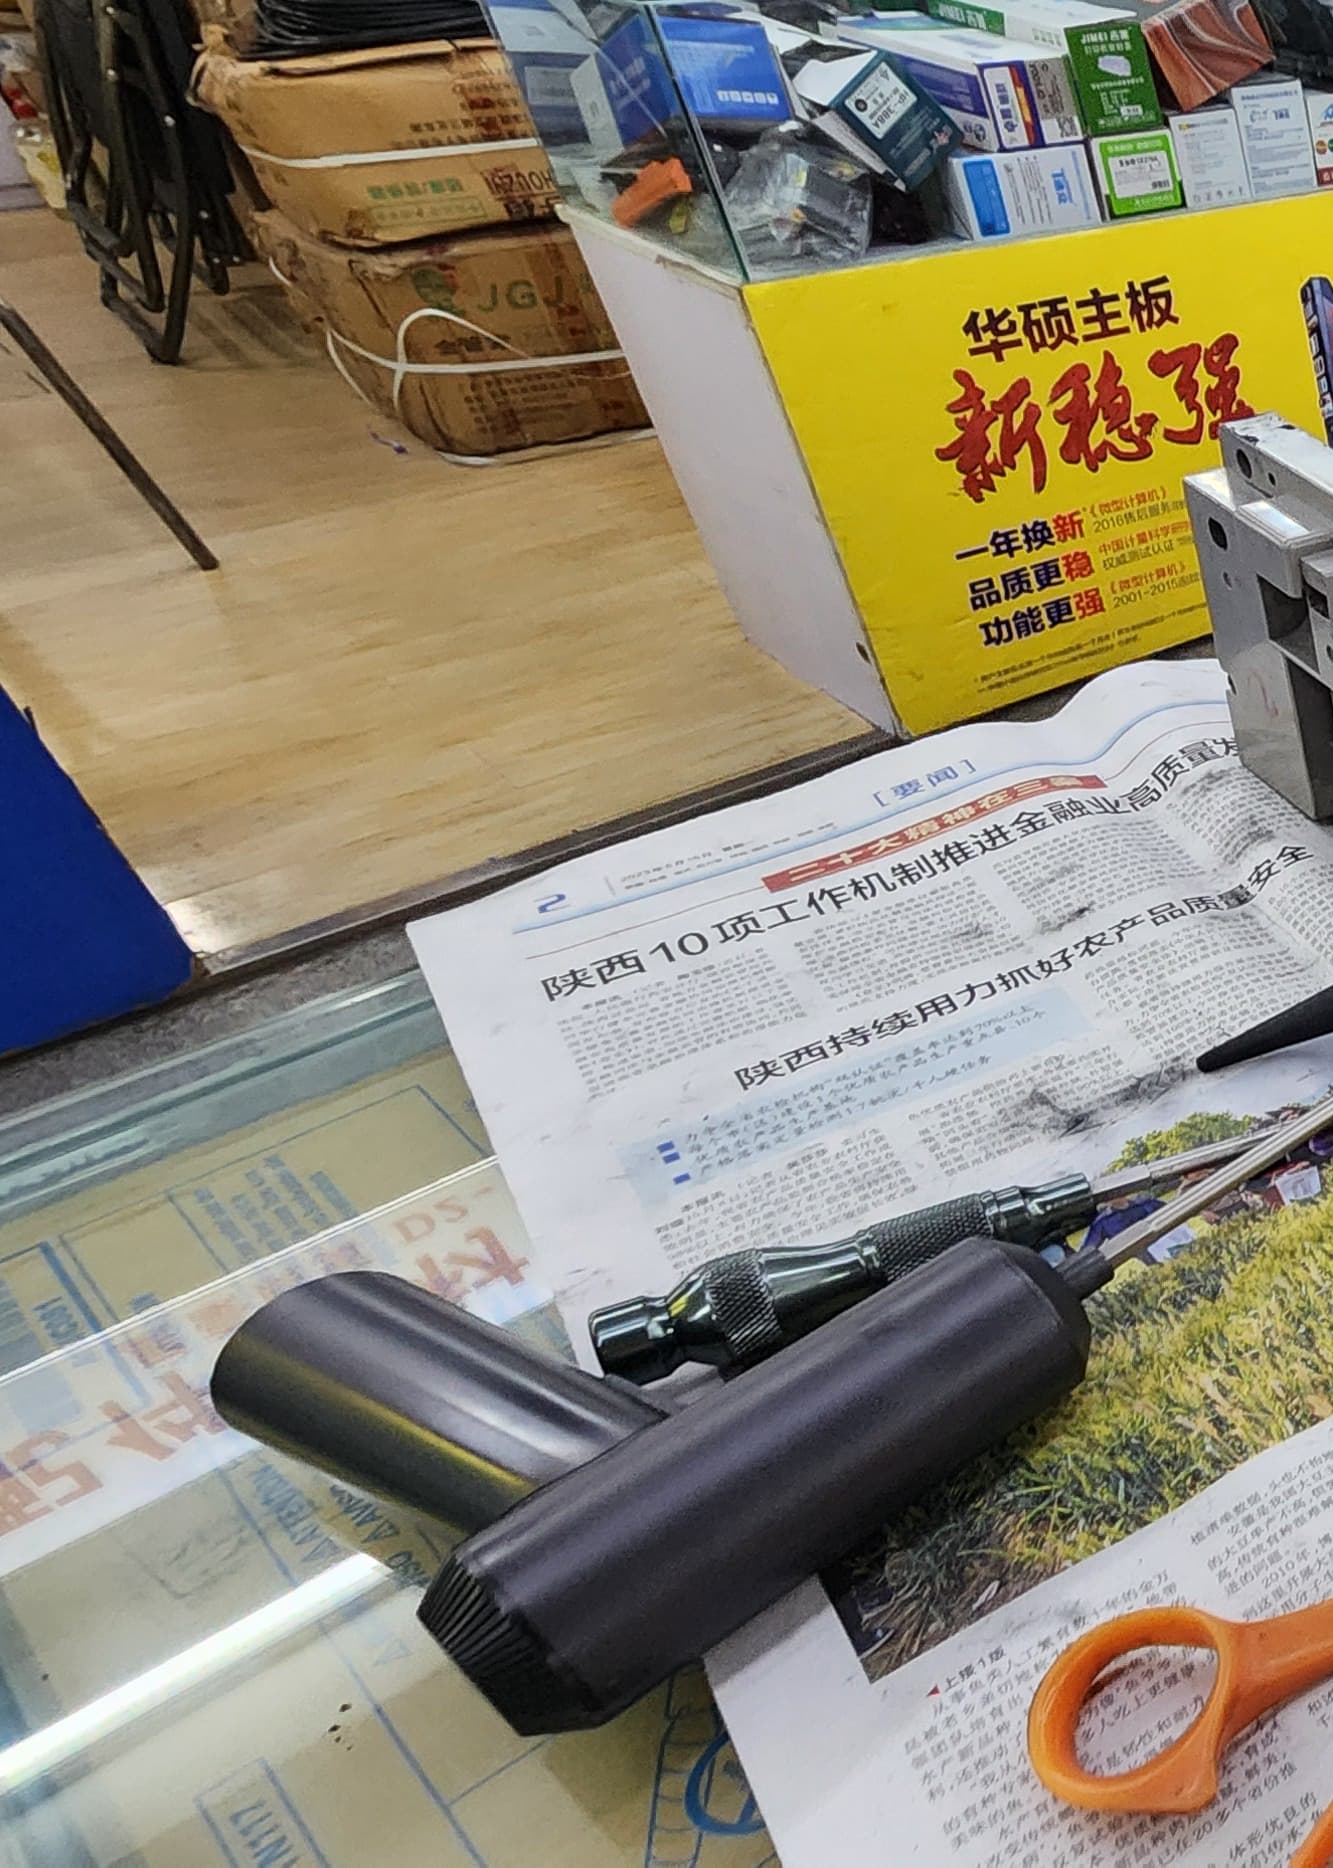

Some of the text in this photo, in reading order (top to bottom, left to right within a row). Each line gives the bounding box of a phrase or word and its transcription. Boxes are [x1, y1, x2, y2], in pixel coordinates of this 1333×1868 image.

[961, 275, 1180, 363] 华硕主板
[935, 333, 1258, 502] 新稳强
[955, 511, 1083, 560] 一年换新
[968, 550, 1095, 611] 品质更稳
[979, 587, 1106, 648] 功能更强
[538, 894, 566, 913] 2
[734, 844, 1313, 1090] 陕西持续用力抓好农产品质量安全
